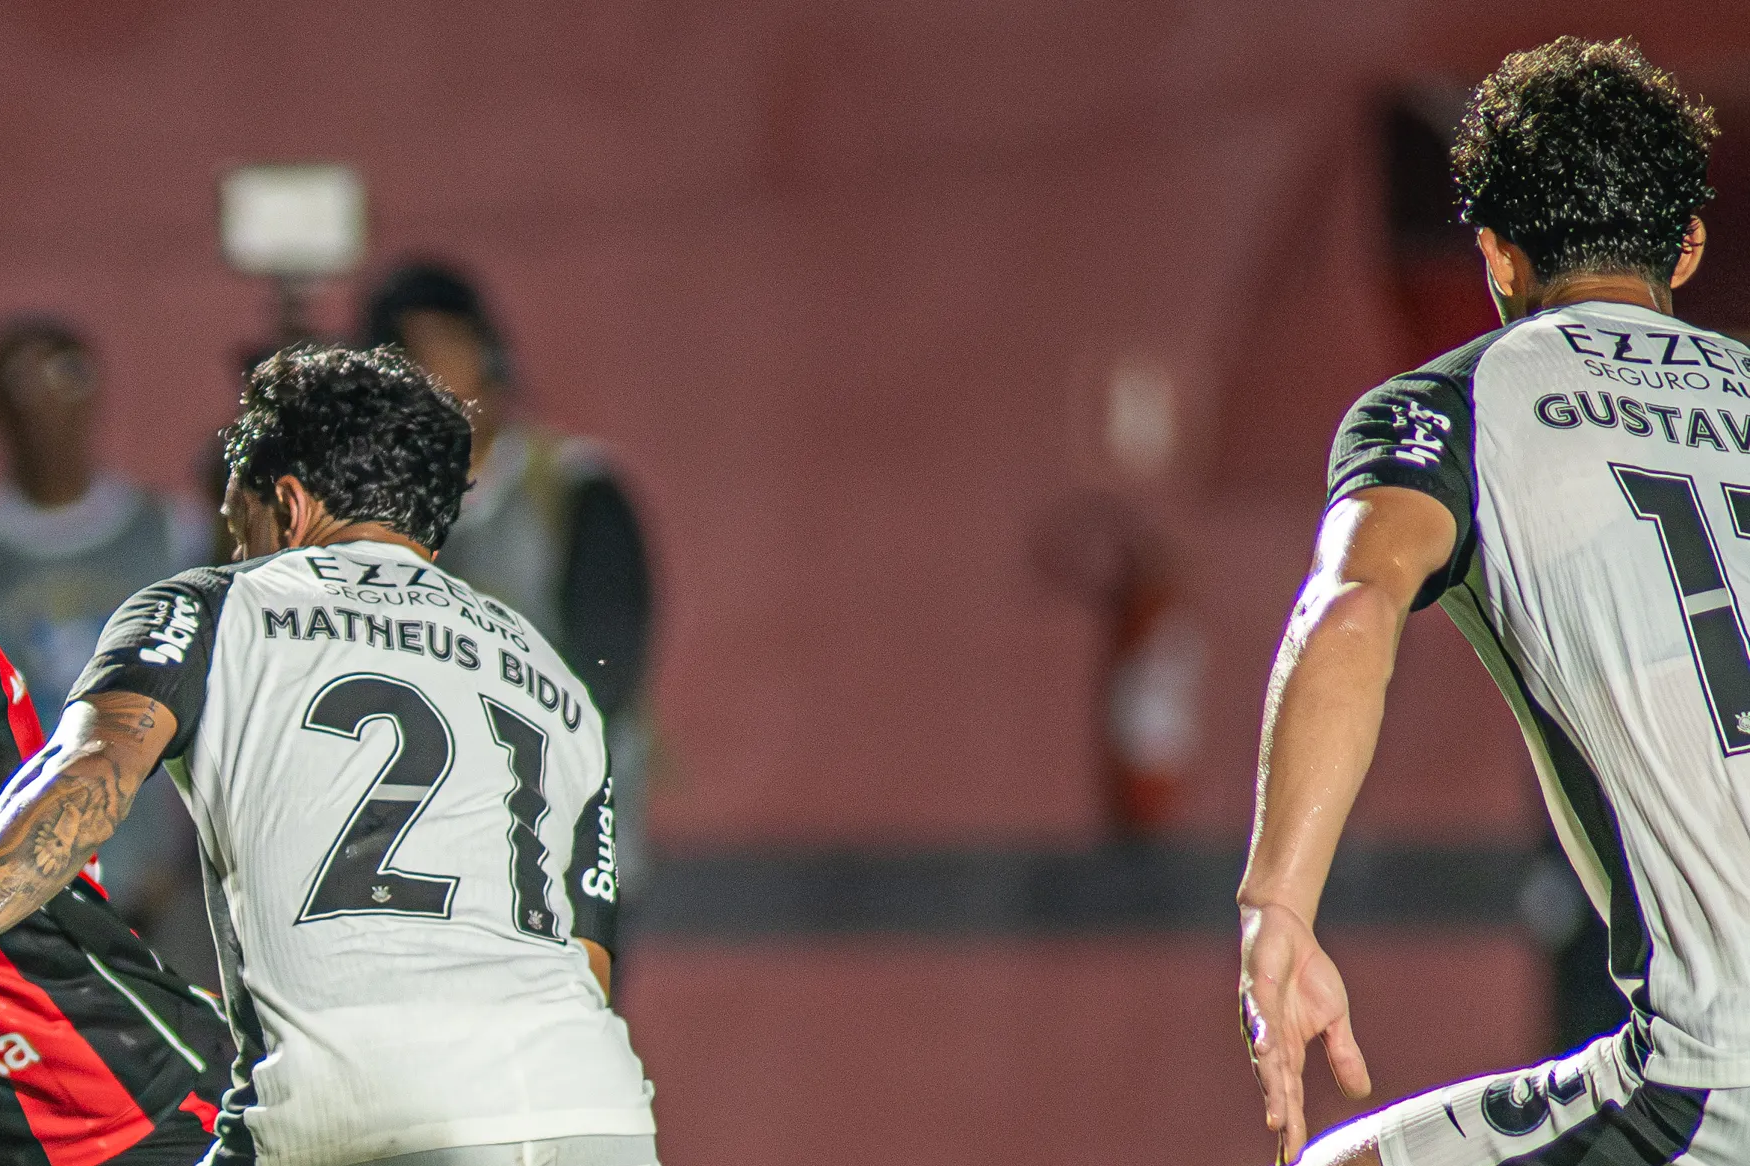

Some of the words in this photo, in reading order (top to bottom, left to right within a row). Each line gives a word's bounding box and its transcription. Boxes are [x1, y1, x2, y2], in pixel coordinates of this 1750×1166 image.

[1554, 324, 1736, 375] EZZE
[1583, 359, 1711, 390] SEGURO
[324, 583, 450, 607] SEGURO
[459, 606, 531, 653] AUTO
[262, 606, 481, 671] MATHEUS
[498, 647, 582, 733] BIDU
[294, 671, 569, 946] 21
